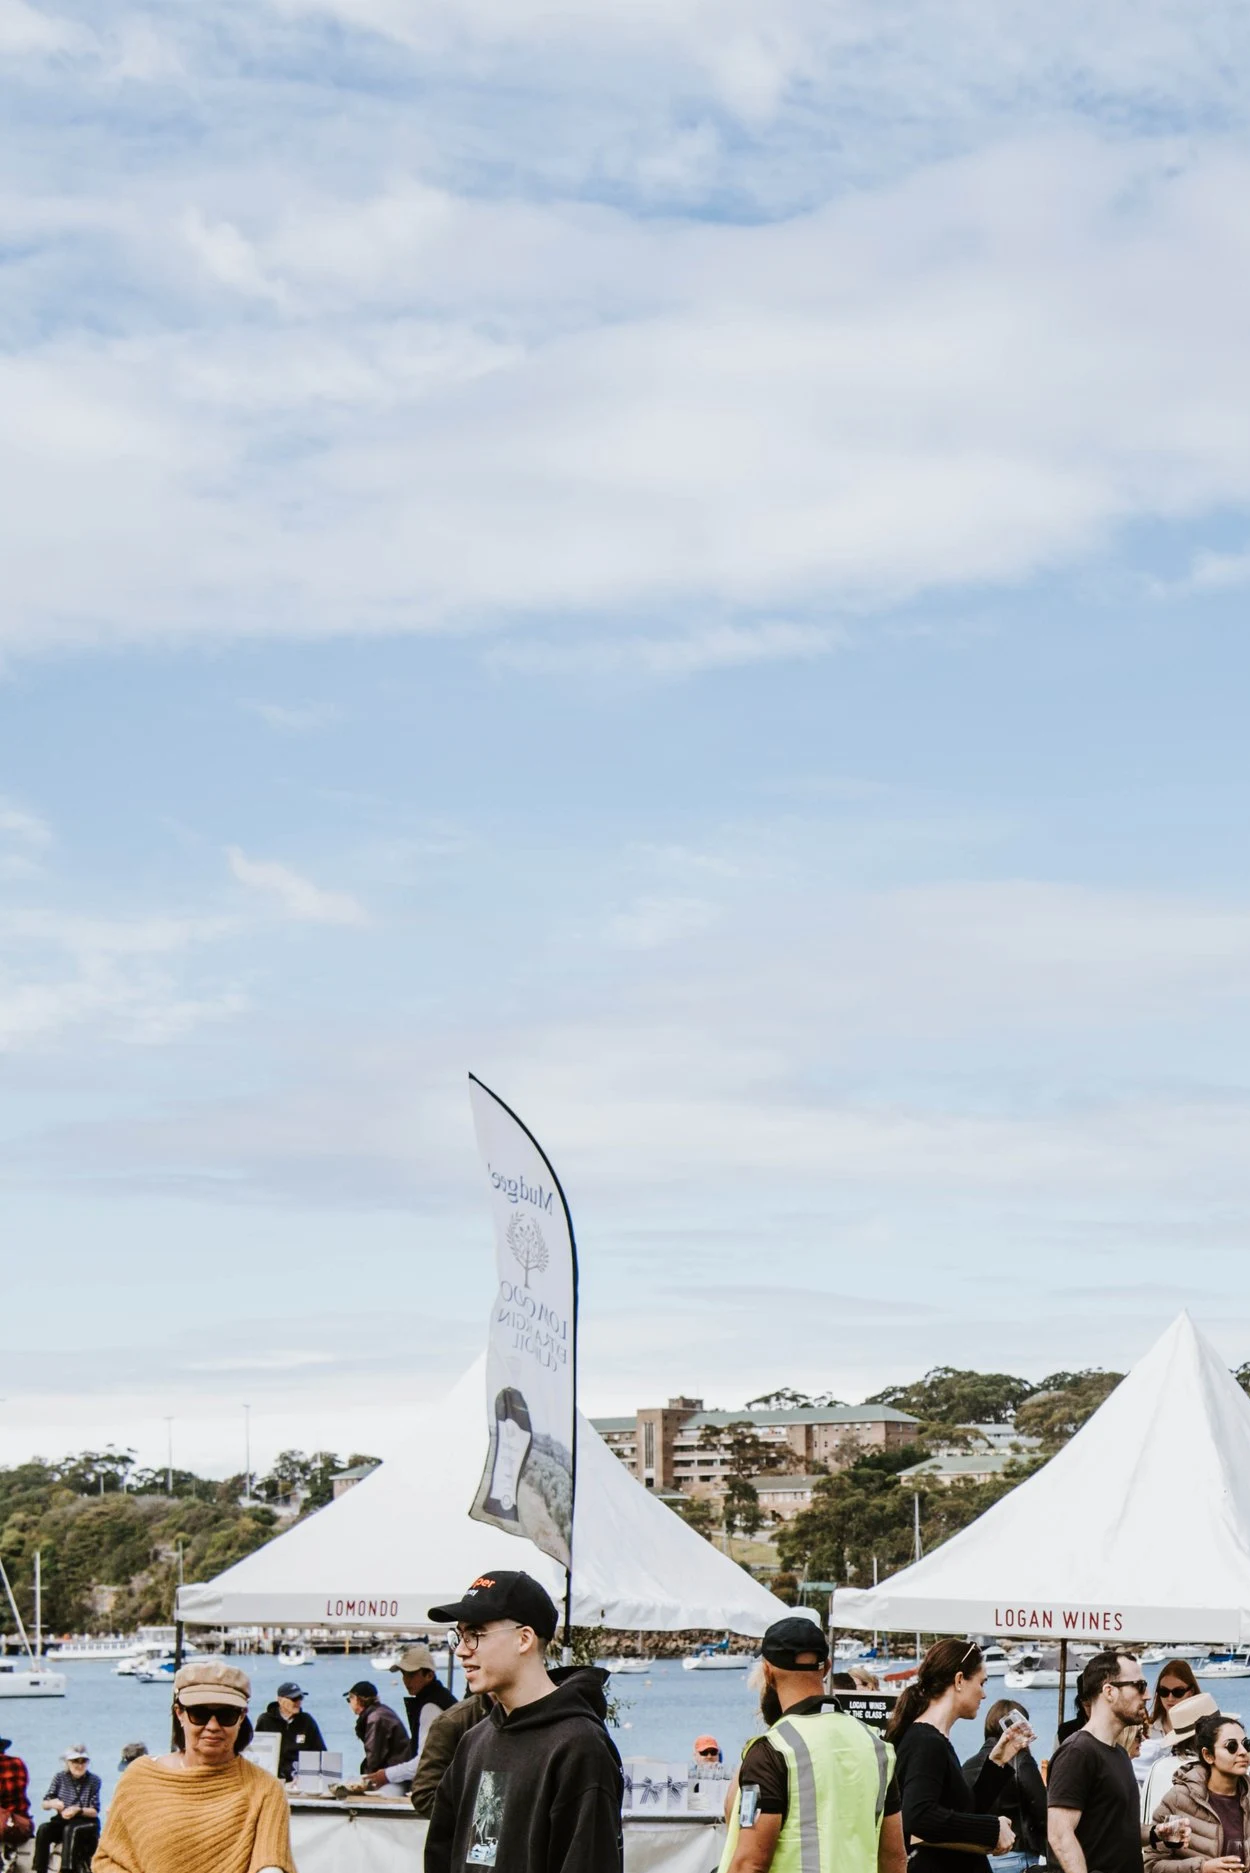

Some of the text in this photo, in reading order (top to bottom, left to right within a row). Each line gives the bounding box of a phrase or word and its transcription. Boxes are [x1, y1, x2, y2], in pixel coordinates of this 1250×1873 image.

[327, 1599, 399, 1617] LOMONDO
[995, 1608, 1124, 1631] LOGAN WINES
[849, 1701, 886, 1710] LOGAN WINES
